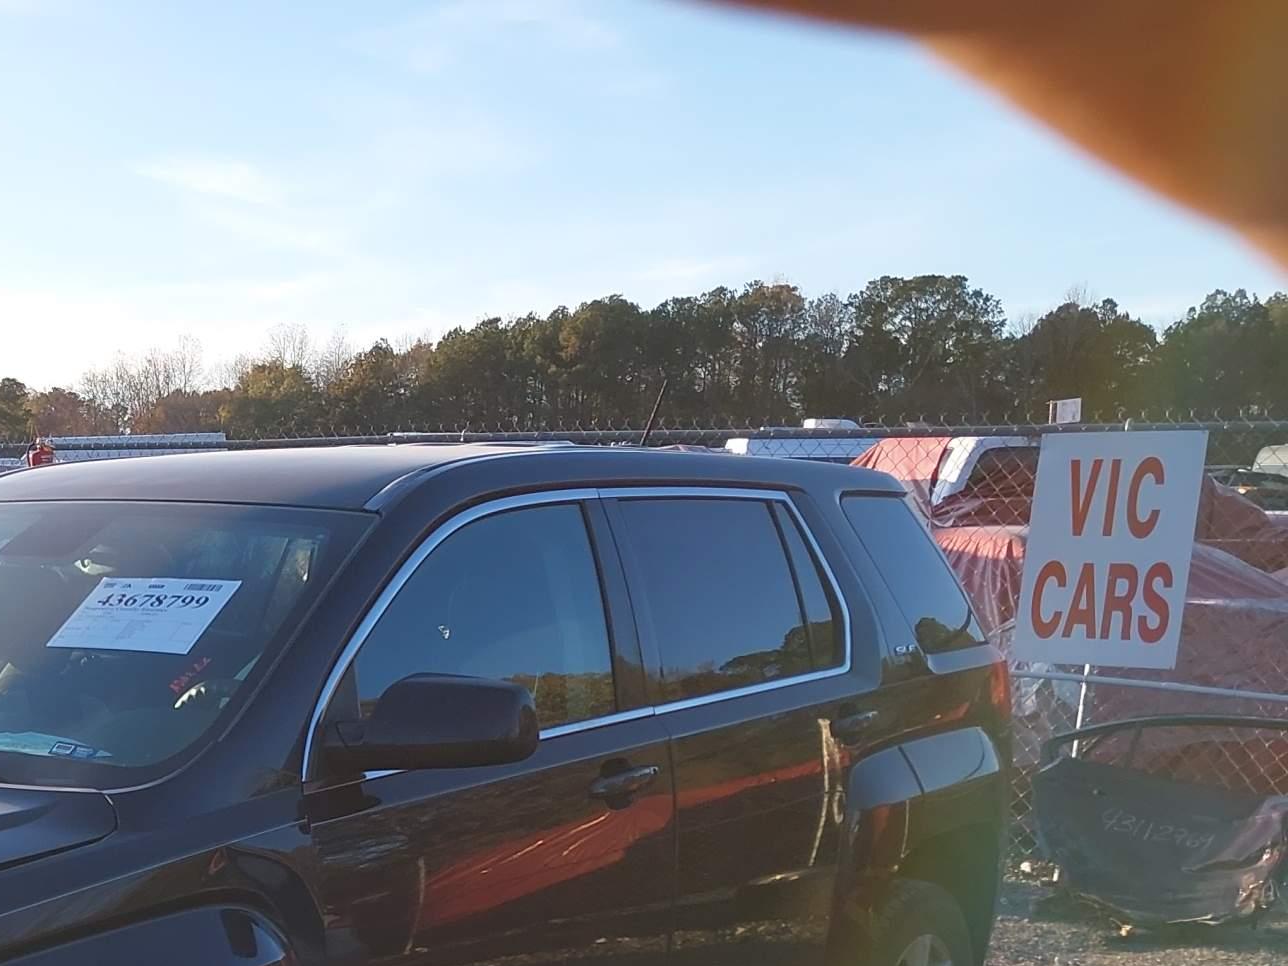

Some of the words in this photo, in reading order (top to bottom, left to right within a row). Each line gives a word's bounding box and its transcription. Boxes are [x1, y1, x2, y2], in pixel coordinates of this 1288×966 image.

[1070, 456, 1165, 539] VIC
[97, 593, 210, 609] 43678799
[1031, 560, 1173, 644] CARS
